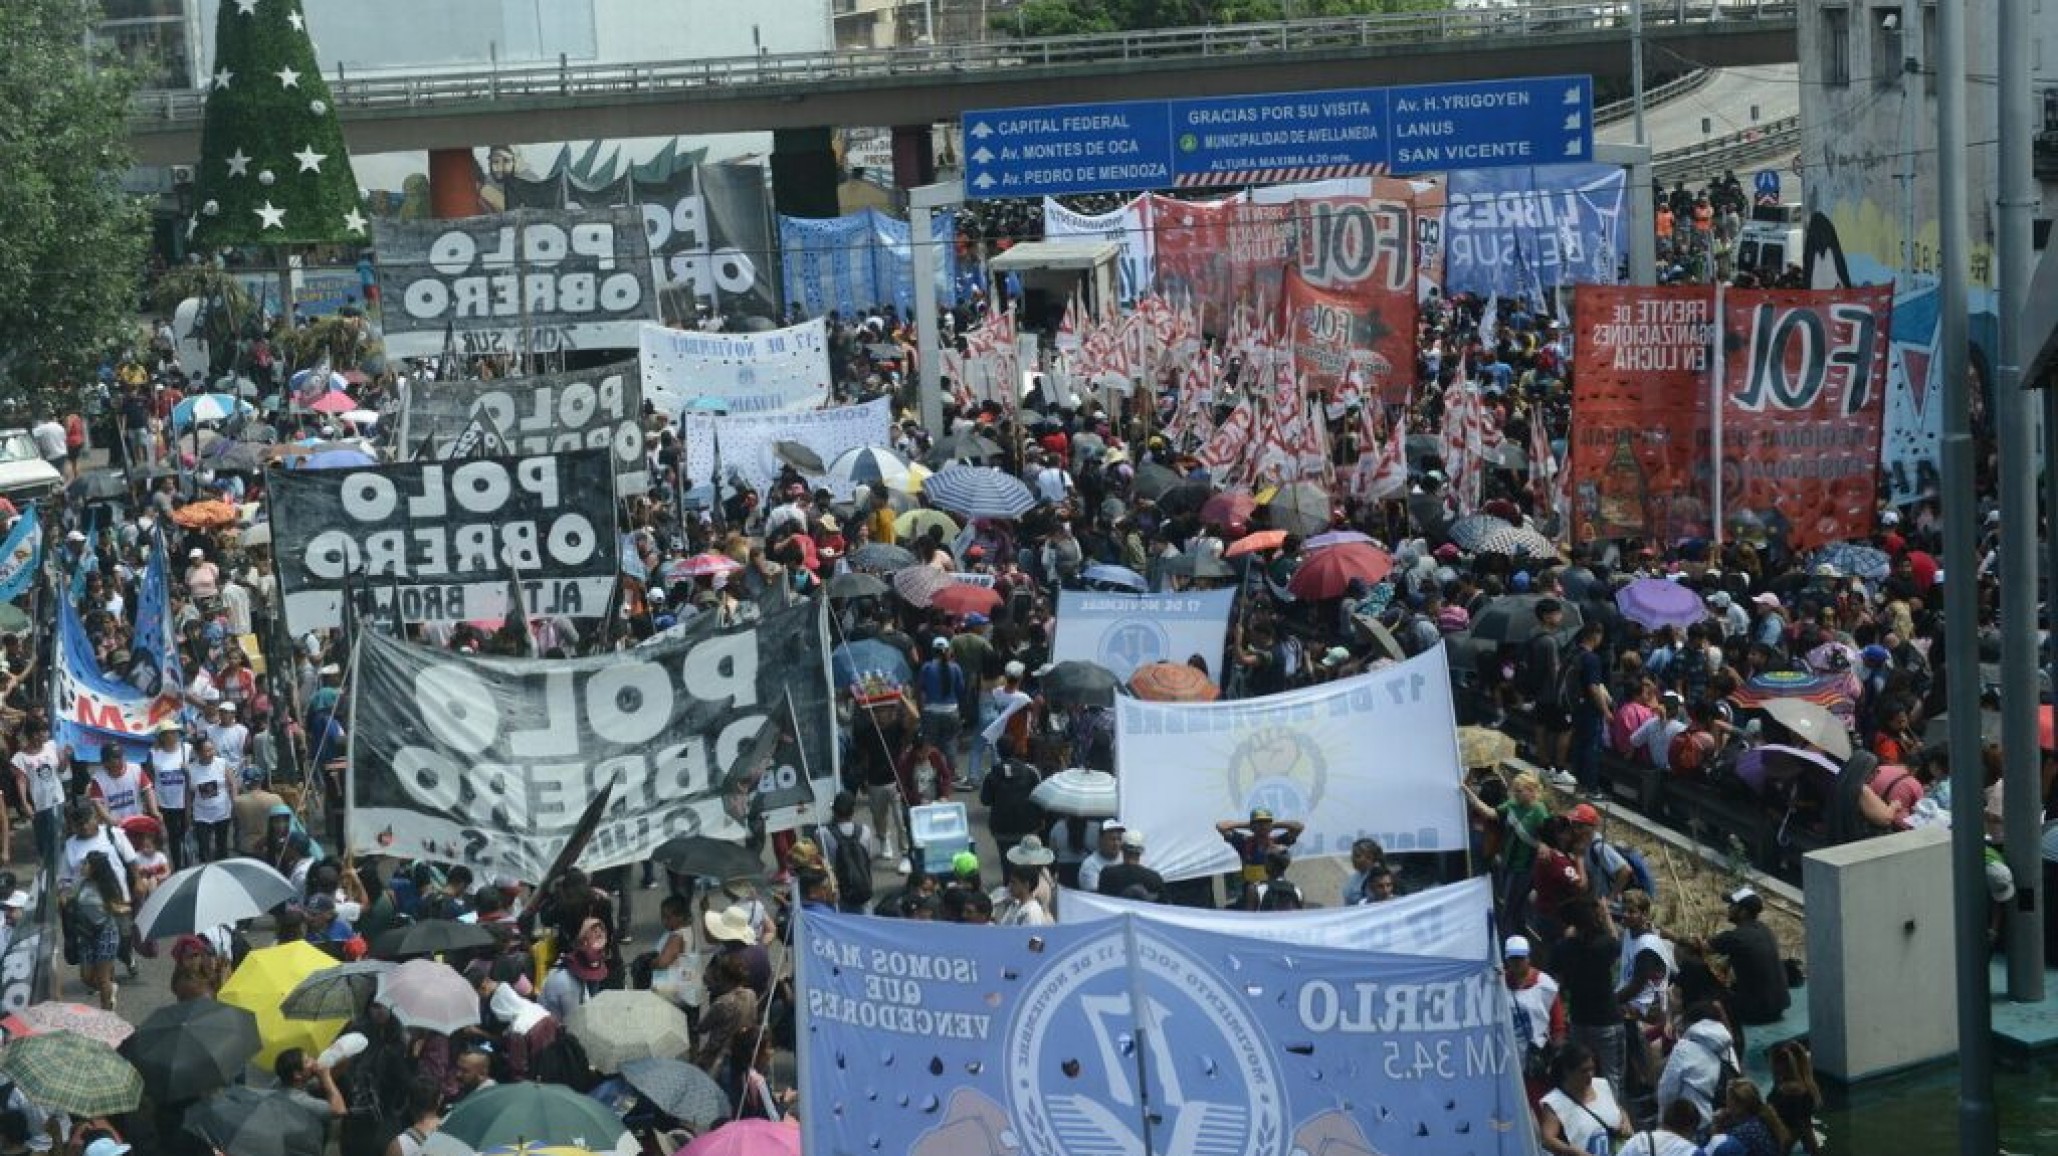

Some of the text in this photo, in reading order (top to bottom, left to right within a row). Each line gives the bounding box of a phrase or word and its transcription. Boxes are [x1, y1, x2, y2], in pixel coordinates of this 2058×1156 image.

[1187, 102, 1371, 125] GRACIAS POR SU VISITA
[1397, 98, 1420, 112] Av.
[999, 115, 1130, 135] CAPITAL FEDERAL
[1397, 121, 1454, 137] LANUS
[1204, 125, 1378, 149] MUNICIPALIDAD DE AVELLANEDA
[1000, 139, 1138, 160] Av. MONTES DE OCA
[1398, 141, 1530, 163] SAN VICENTE
[1211, 158, 1256, 171] ALTURA
[1257, 155, 1304, 168] MAXIMA
[1002, 163, 1168, 186] Av. PEDRO DE MENDOZA
